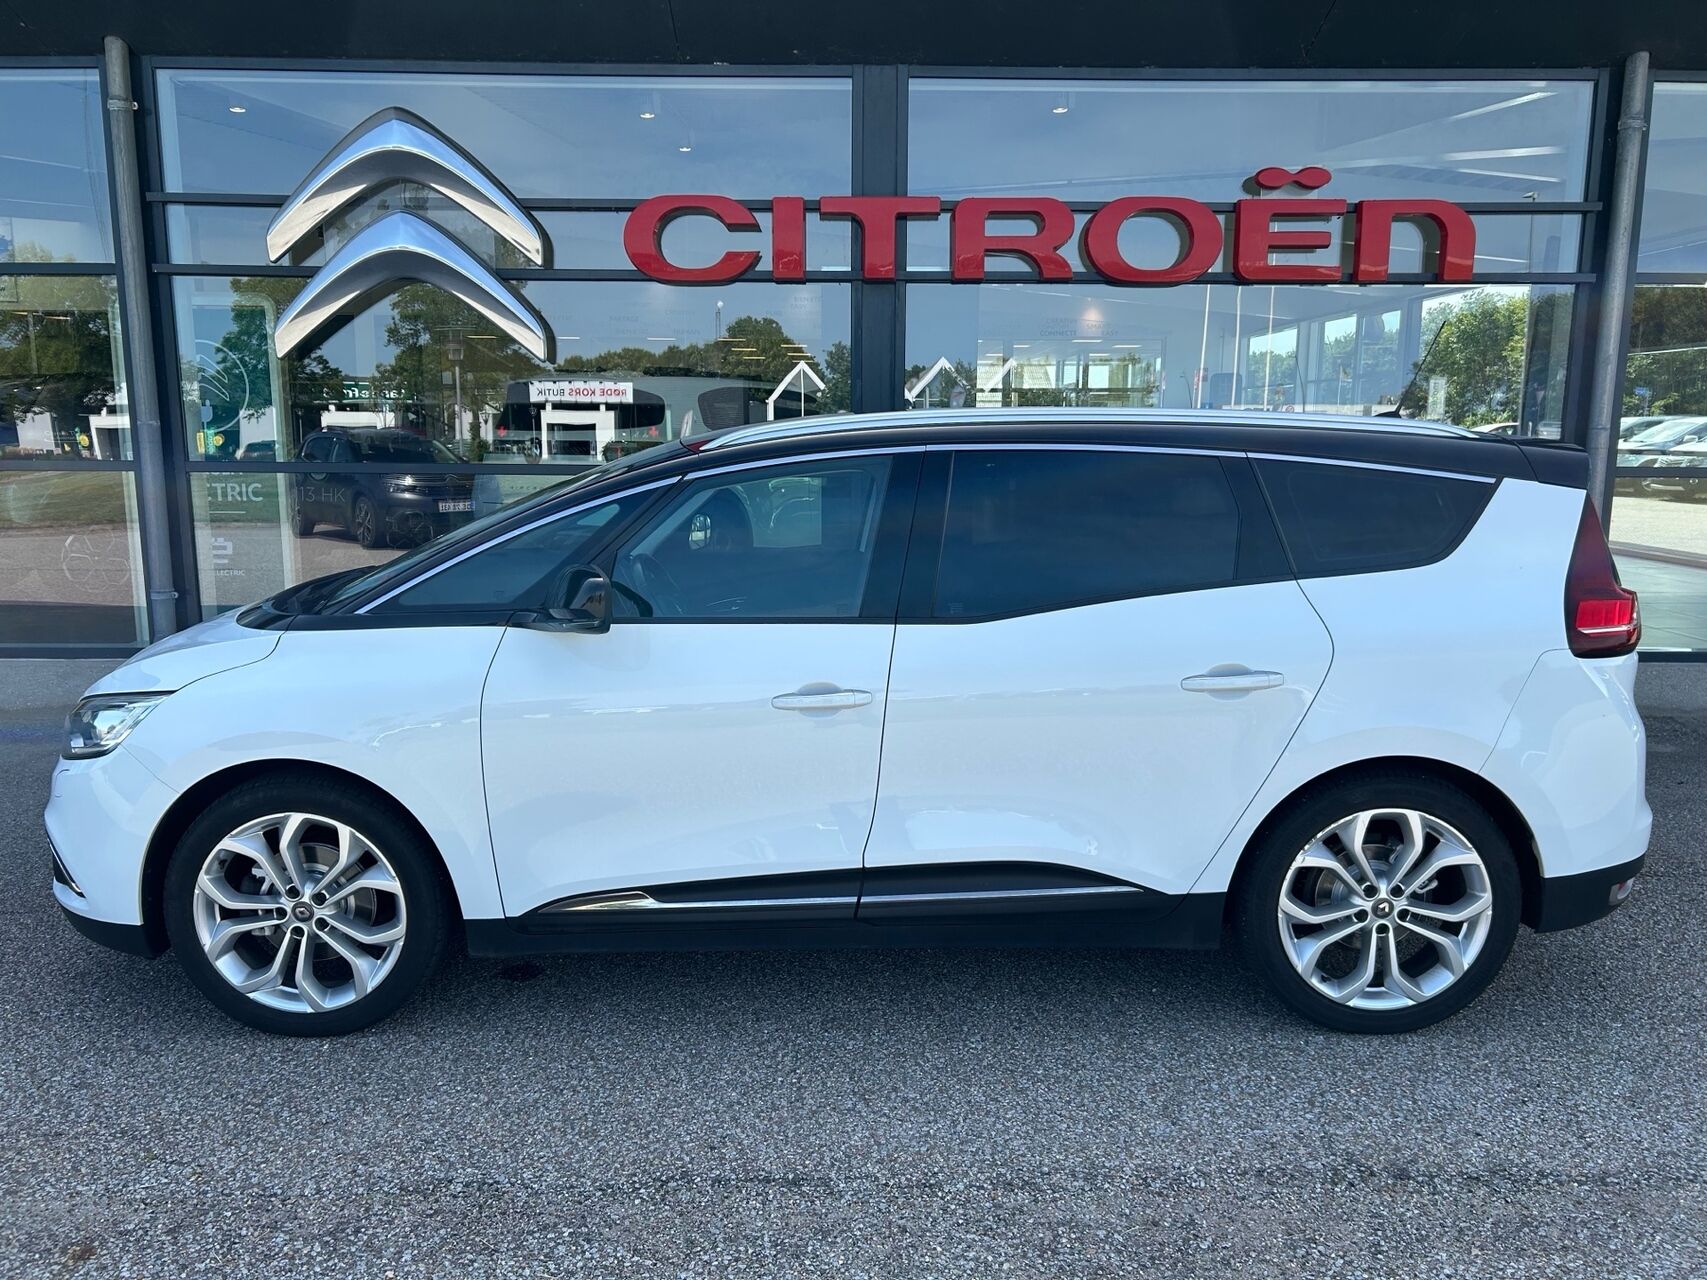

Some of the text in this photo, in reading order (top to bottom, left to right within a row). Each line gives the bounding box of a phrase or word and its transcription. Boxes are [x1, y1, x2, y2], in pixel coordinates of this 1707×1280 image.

[623, 166, 1477, 284] CITROËN
[207, 482, 264, 502] TRIC
[322, 487, 345, 503] HK
